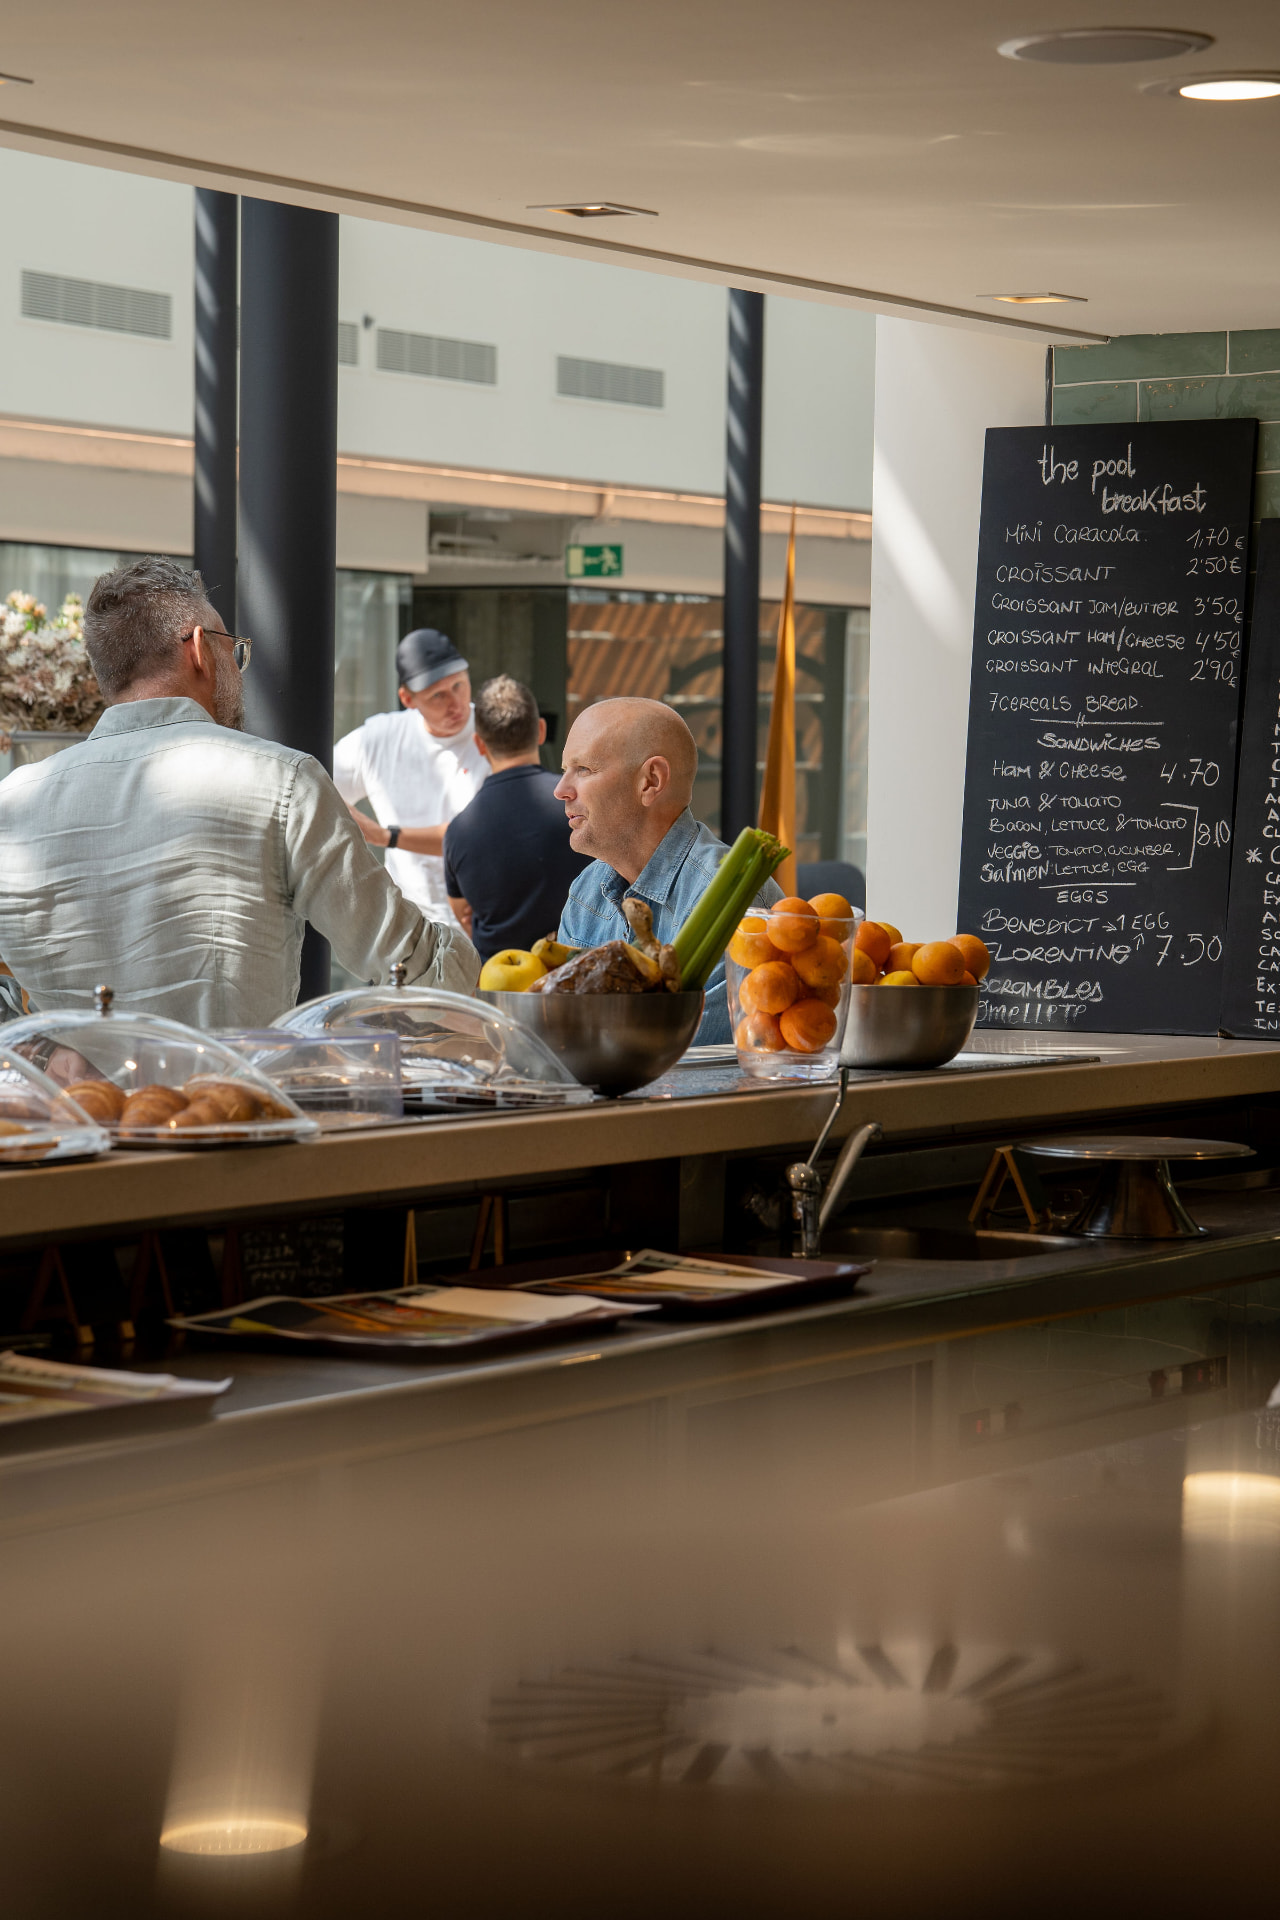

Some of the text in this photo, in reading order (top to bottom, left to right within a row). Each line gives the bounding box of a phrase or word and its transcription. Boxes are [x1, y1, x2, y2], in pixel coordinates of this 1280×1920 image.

[1037, 441, 1136, 495] the pool
[1101, 482, 1208, 515] breakfast
[1038, 760, 1056, 781] &
[1038, 792, 1058, 812] &
[1056, 890, 1109, 904] EGGS
[1131, 911, 1170, 930] EGG
